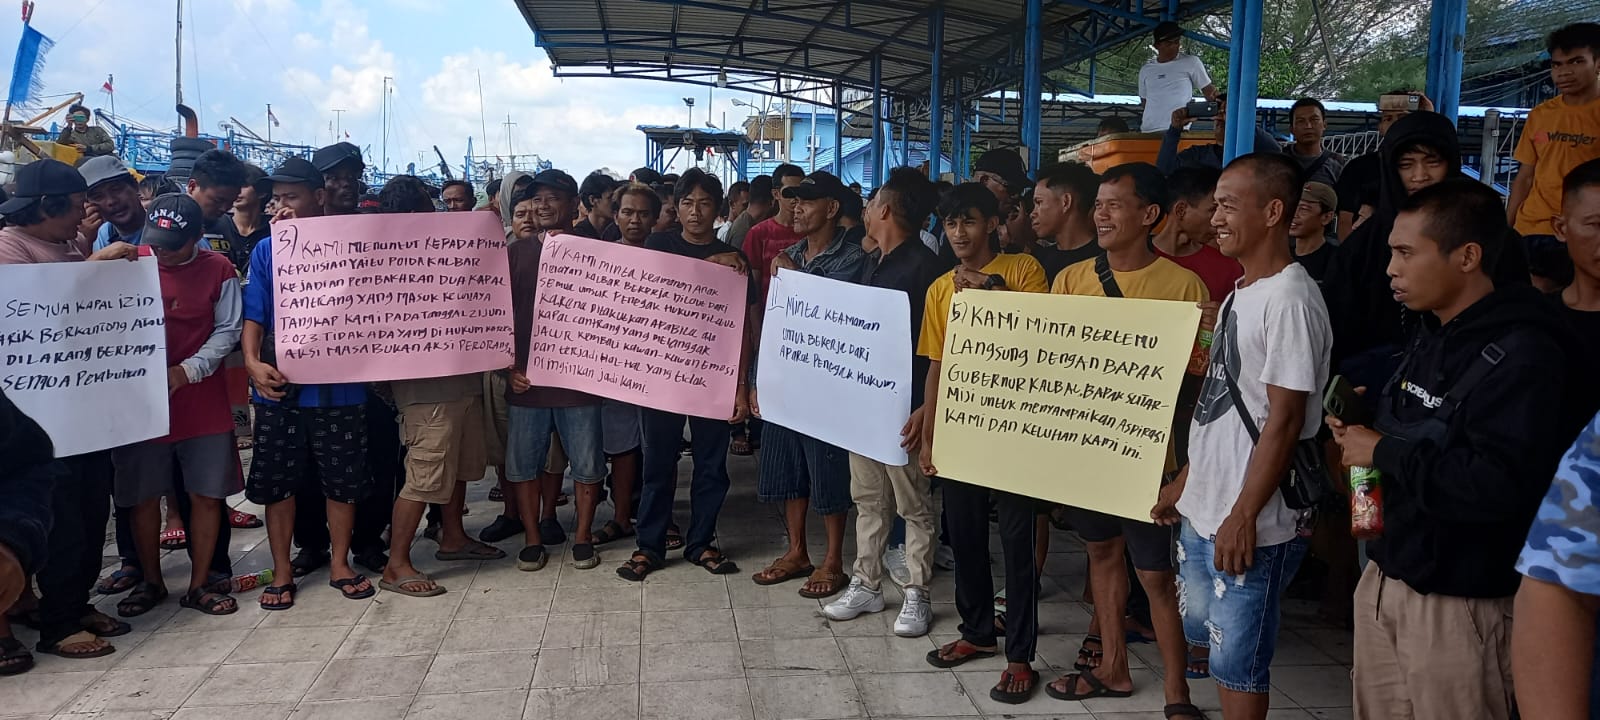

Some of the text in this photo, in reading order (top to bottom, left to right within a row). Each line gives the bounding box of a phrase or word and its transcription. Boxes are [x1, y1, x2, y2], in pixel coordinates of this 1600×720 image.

[1547, 130, 1597, 148] Wrangler
[148, 208, 188, 230] CANADA
[276, 224, 298, 259] 3)
[426, 256, 481, 267] KALBAR
[439, 275, 466, 286] DUA
[467, 274, 507, 287] KAPAL
[397, 292, 440, 306] MASUK
[5, 299, 70, 318] SEMUA
[76, 299, 113, 314] KAPAL
[385, 312, 420, 322] PADA
[950, 301, 968, 323] 5)
[367, 329, 394, 339] ADA
[327, 344, 369, 357] MASA
[1102, 358, 1165, 381] BAPAK
[3, 374, 70, 391] SEMUA
[1082, 383, 1124, 402] BAPAK
